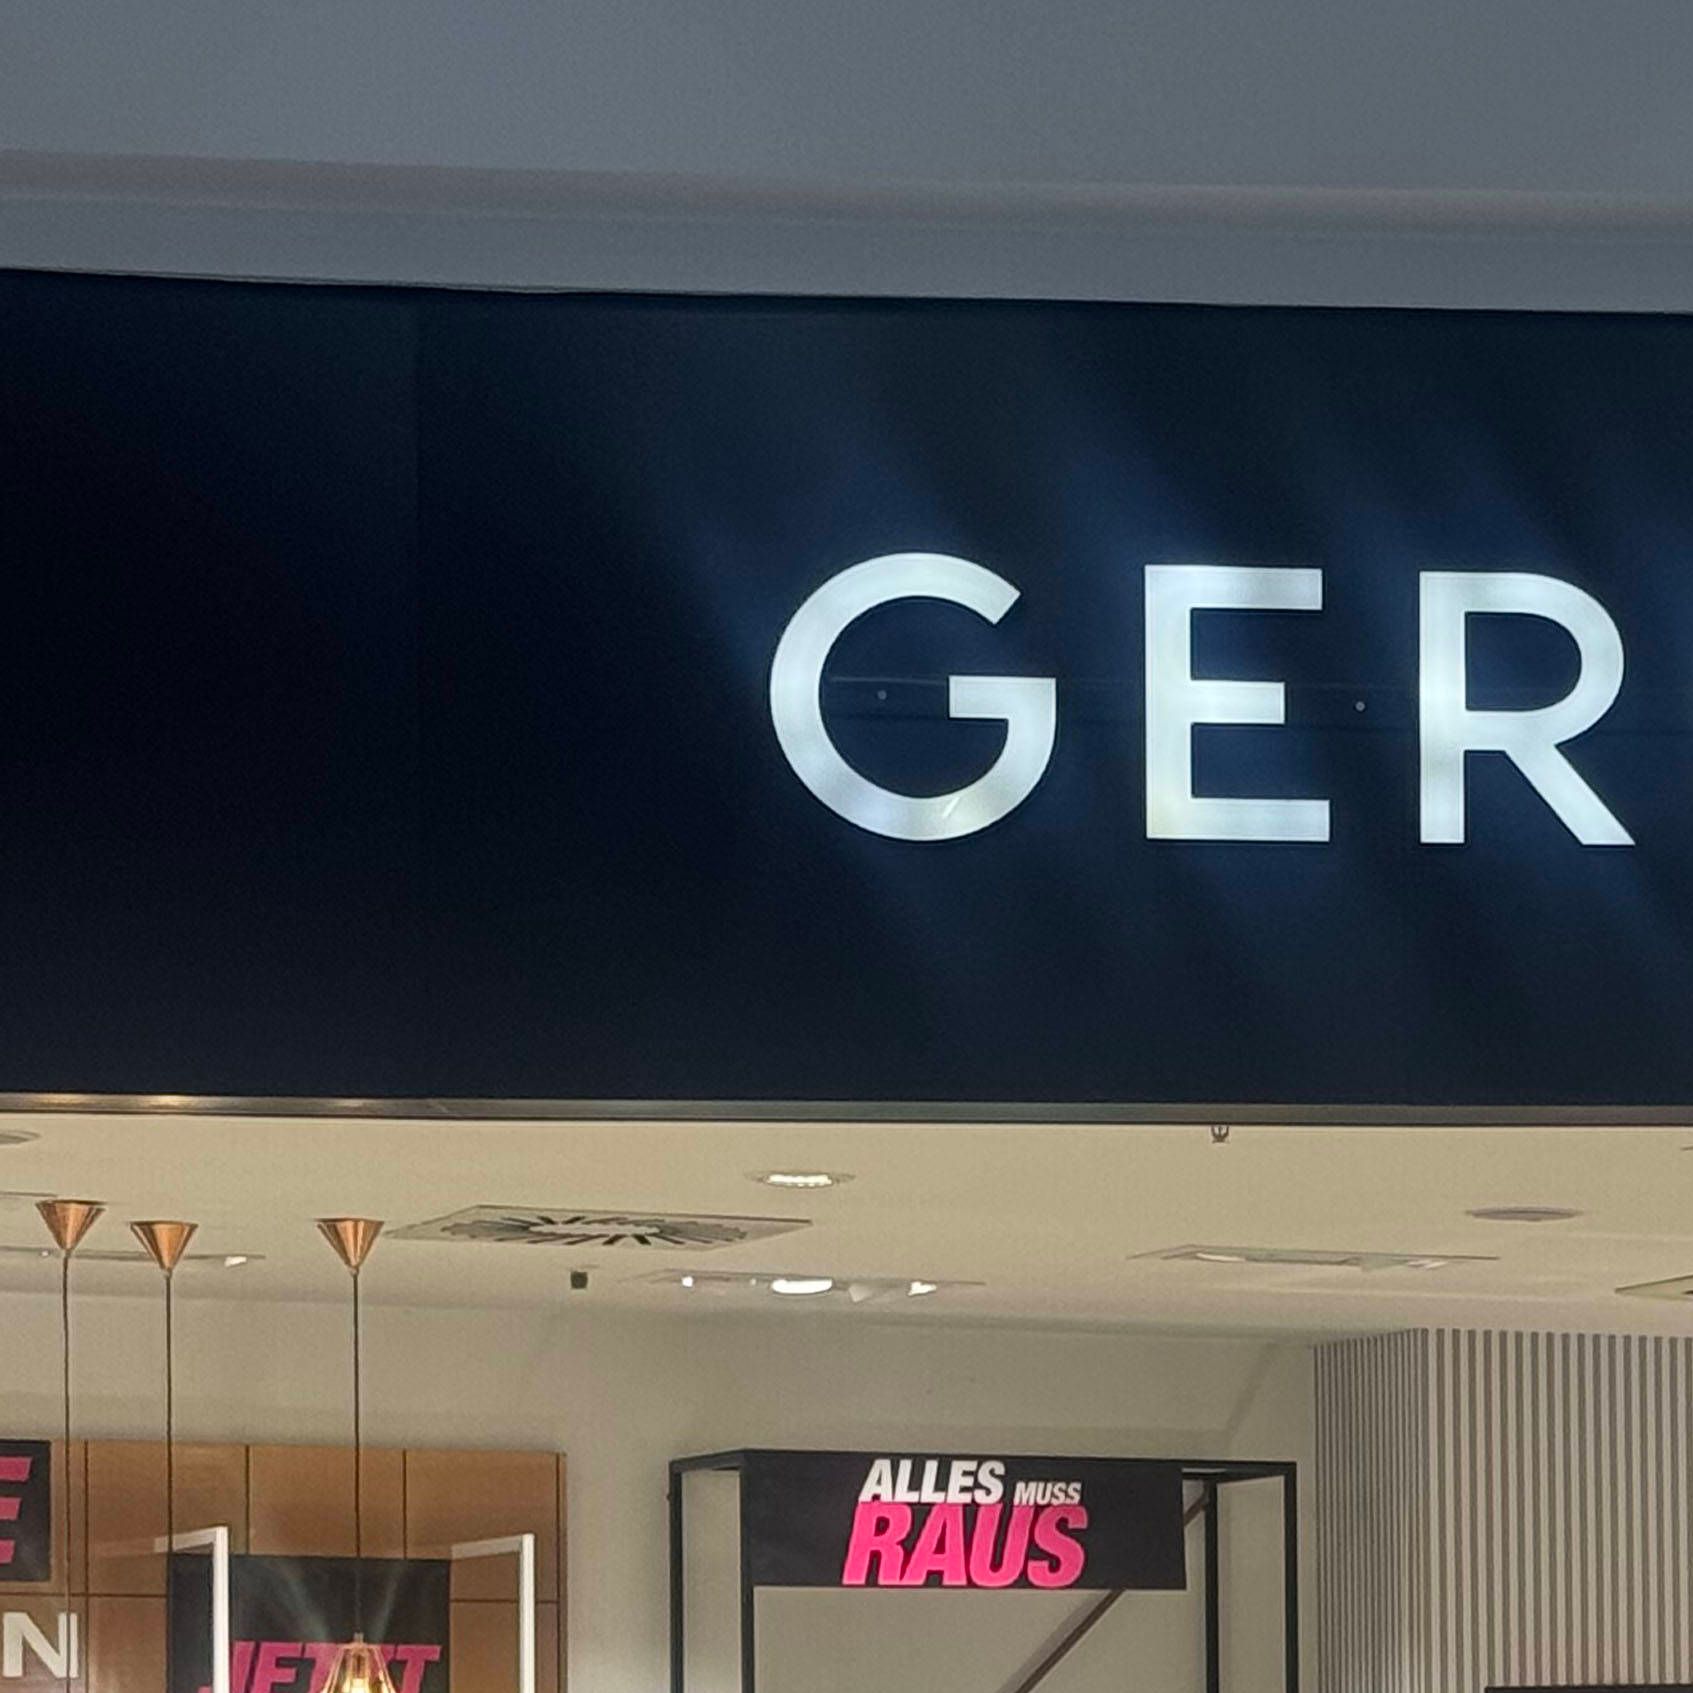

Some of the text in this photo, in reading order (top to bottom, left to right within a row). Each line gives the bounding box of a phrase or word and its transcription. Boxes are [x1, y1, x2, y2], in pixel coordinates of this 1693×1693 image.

[859, 1458, 1082, 1507] ALLES MUSS
[842, 1501, 1088, 1588] RAUS
